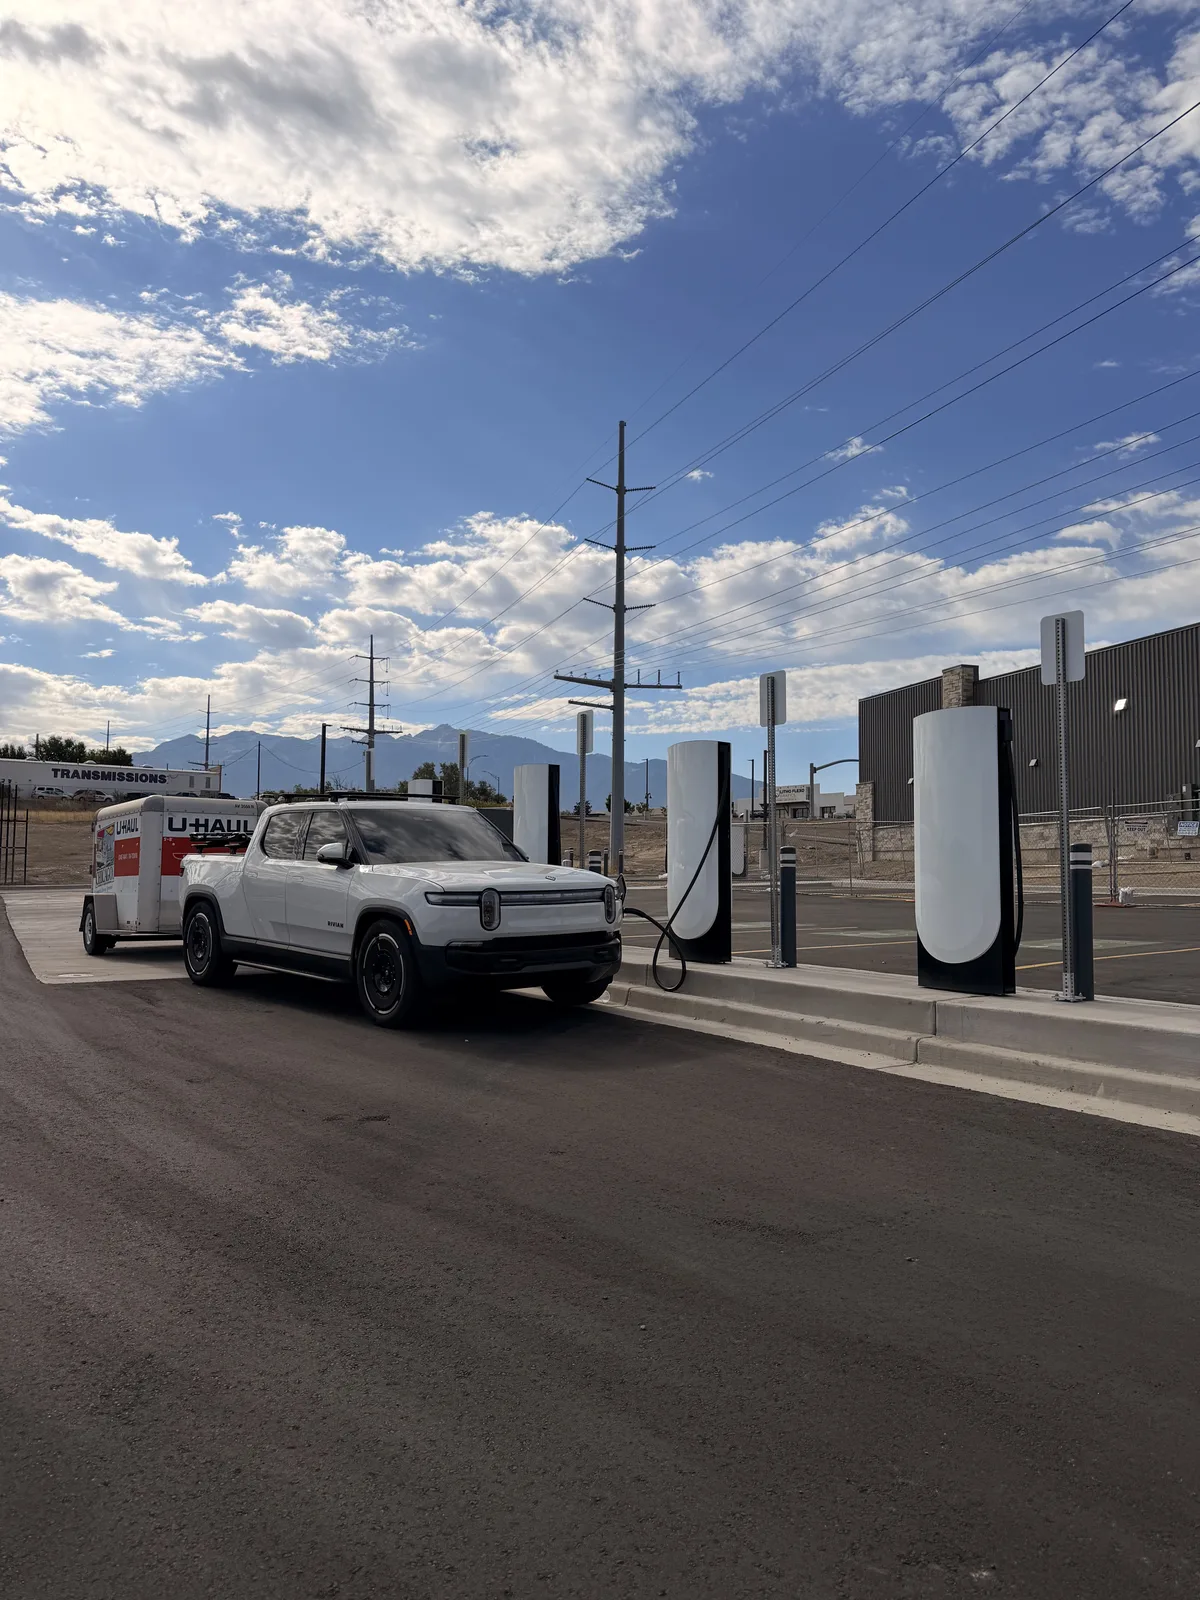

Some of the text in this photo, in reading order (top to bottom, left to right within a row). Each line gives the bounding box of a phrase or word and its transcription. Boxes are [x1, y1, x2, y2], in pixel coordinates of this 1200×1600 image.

[52, 768, 167, 784] TRANSMISSIONS
[116, 818, 139, 836] U-HAUL
[168, 817, 255, 833] U-HAUL
[327, 920, 344, 929] RIVIAN
